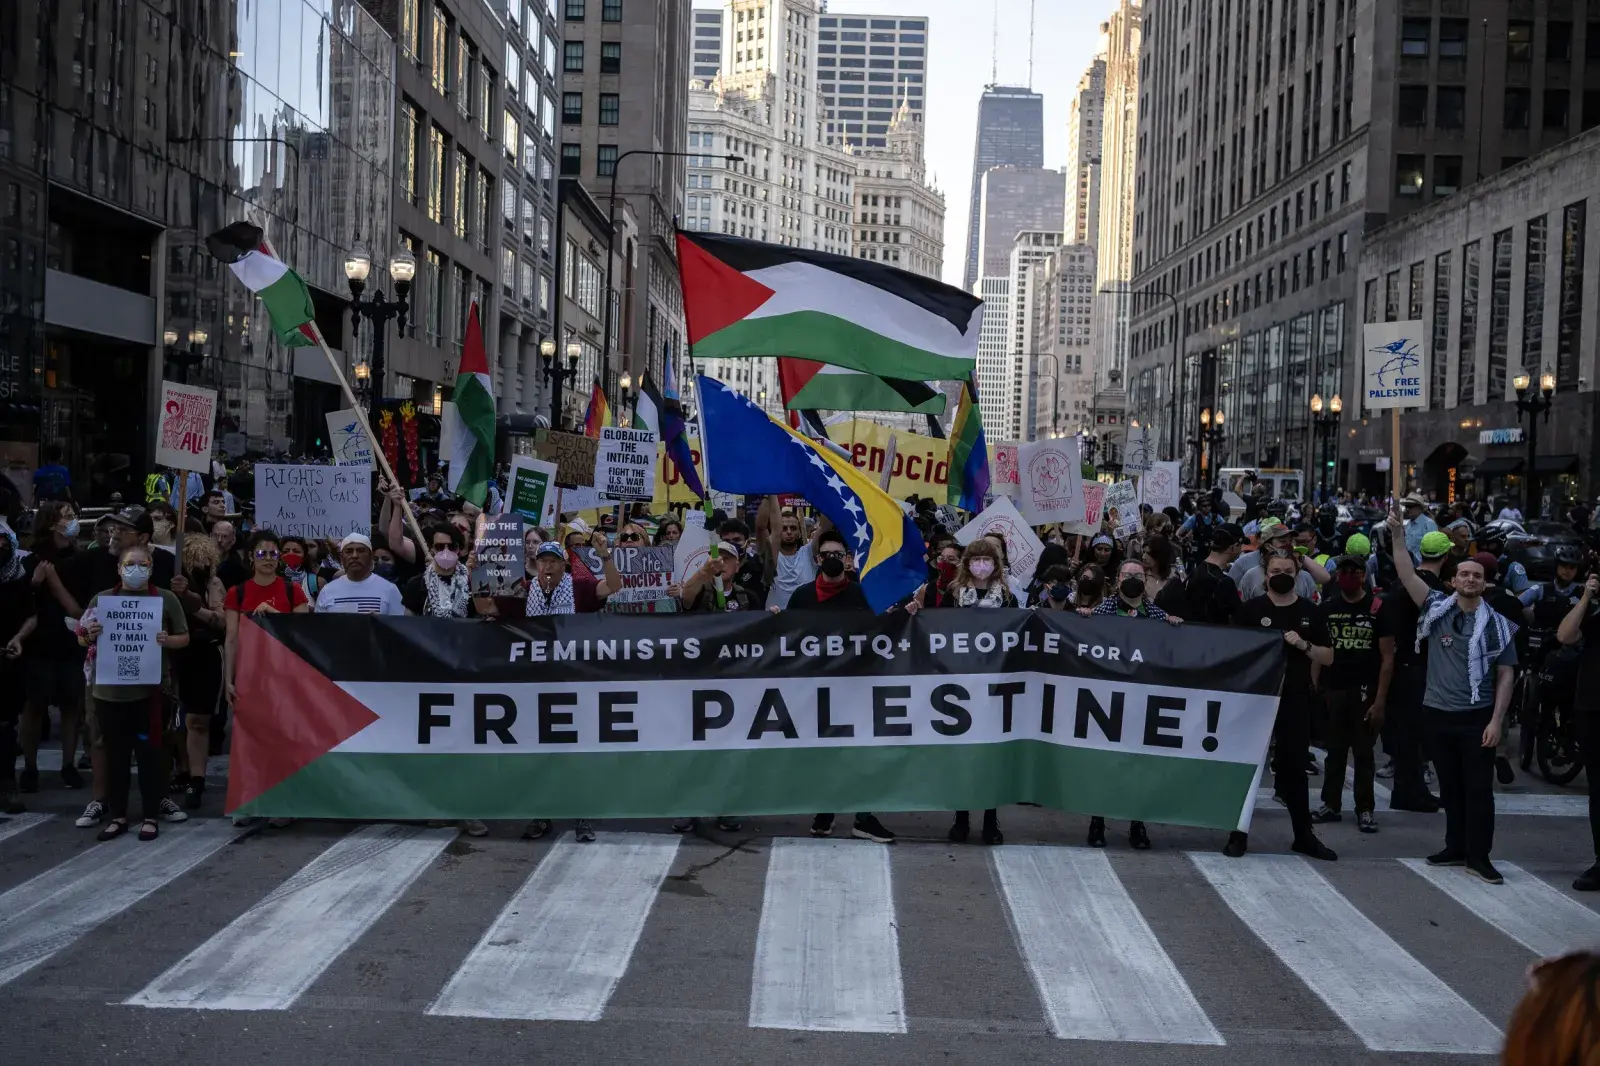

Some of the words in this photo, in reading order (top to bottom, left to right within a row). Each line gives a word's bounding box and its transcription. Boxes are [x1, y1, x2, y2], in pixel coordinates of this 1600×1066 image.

[1395, 378, 1420, 386] FREE
[167, 390, 213, 404] REPRODUCTIVE
[1370, 388, 1420, 397] PALESTINE
[190, 416, 209, 434] FOR
[604, 430, 654, 443] GLOBALIZE
[180, 432, 208, 454] ALL!
[620, 442, 637, 453] THE
[556, 447, 595, 465] DEATH
[607, 452, 649, 464] INTIFADA
[838, 443, 950, 485] enocid
[609, 467, 630, 476] FIGHT
[632, 469, 646, 477] THE
[265, 468, 324, 488] RIGHTS
[351, 472, 367, 485] THE
[609, 476, 624, 485] U.S.
[626, 478, 644, 486] WAR
[330, 486, 359, 503] GALS
[607, 485, 646, 495] MACHINE!
[276, 506, 297, 520] AND
[307, 506, 328, 518] OUR
[262, 521, 343, 537] PALESTINIAN
[480, 522, 496, 530] END
[475, 538, 522, 546] GENOCIDE
[478, 554, 488, 562] IN
[491, 554, 517, 562] GAZA
[588, 547, 639, 573] SOP
[642, 553, 661, 572] the
[487, 569, 512, 577] NOW!
[121, 600, 140, 608] GET
[107, 611, 153, 619] ABORTION
[117, 622, 143, 630] PILLS
[110, 633, 122, 641] BY
[114, 644, 144, 652] TODAY
[509, 638, 701, 662] FEMINISTS
[718, 644, 764, 658] AND
[780, 634, 911, 660] LGBTQ+
[929, 632, 1061, 654] PEOPLE
[1077, 643, 1121, 661] FOR
[1129, 649, 1144, 663] A
[1336, 638, 1373, 649] FUCK
[418, 691, 638, 744] FREE
[692, 682, 1222, 753] PALESTINE!
